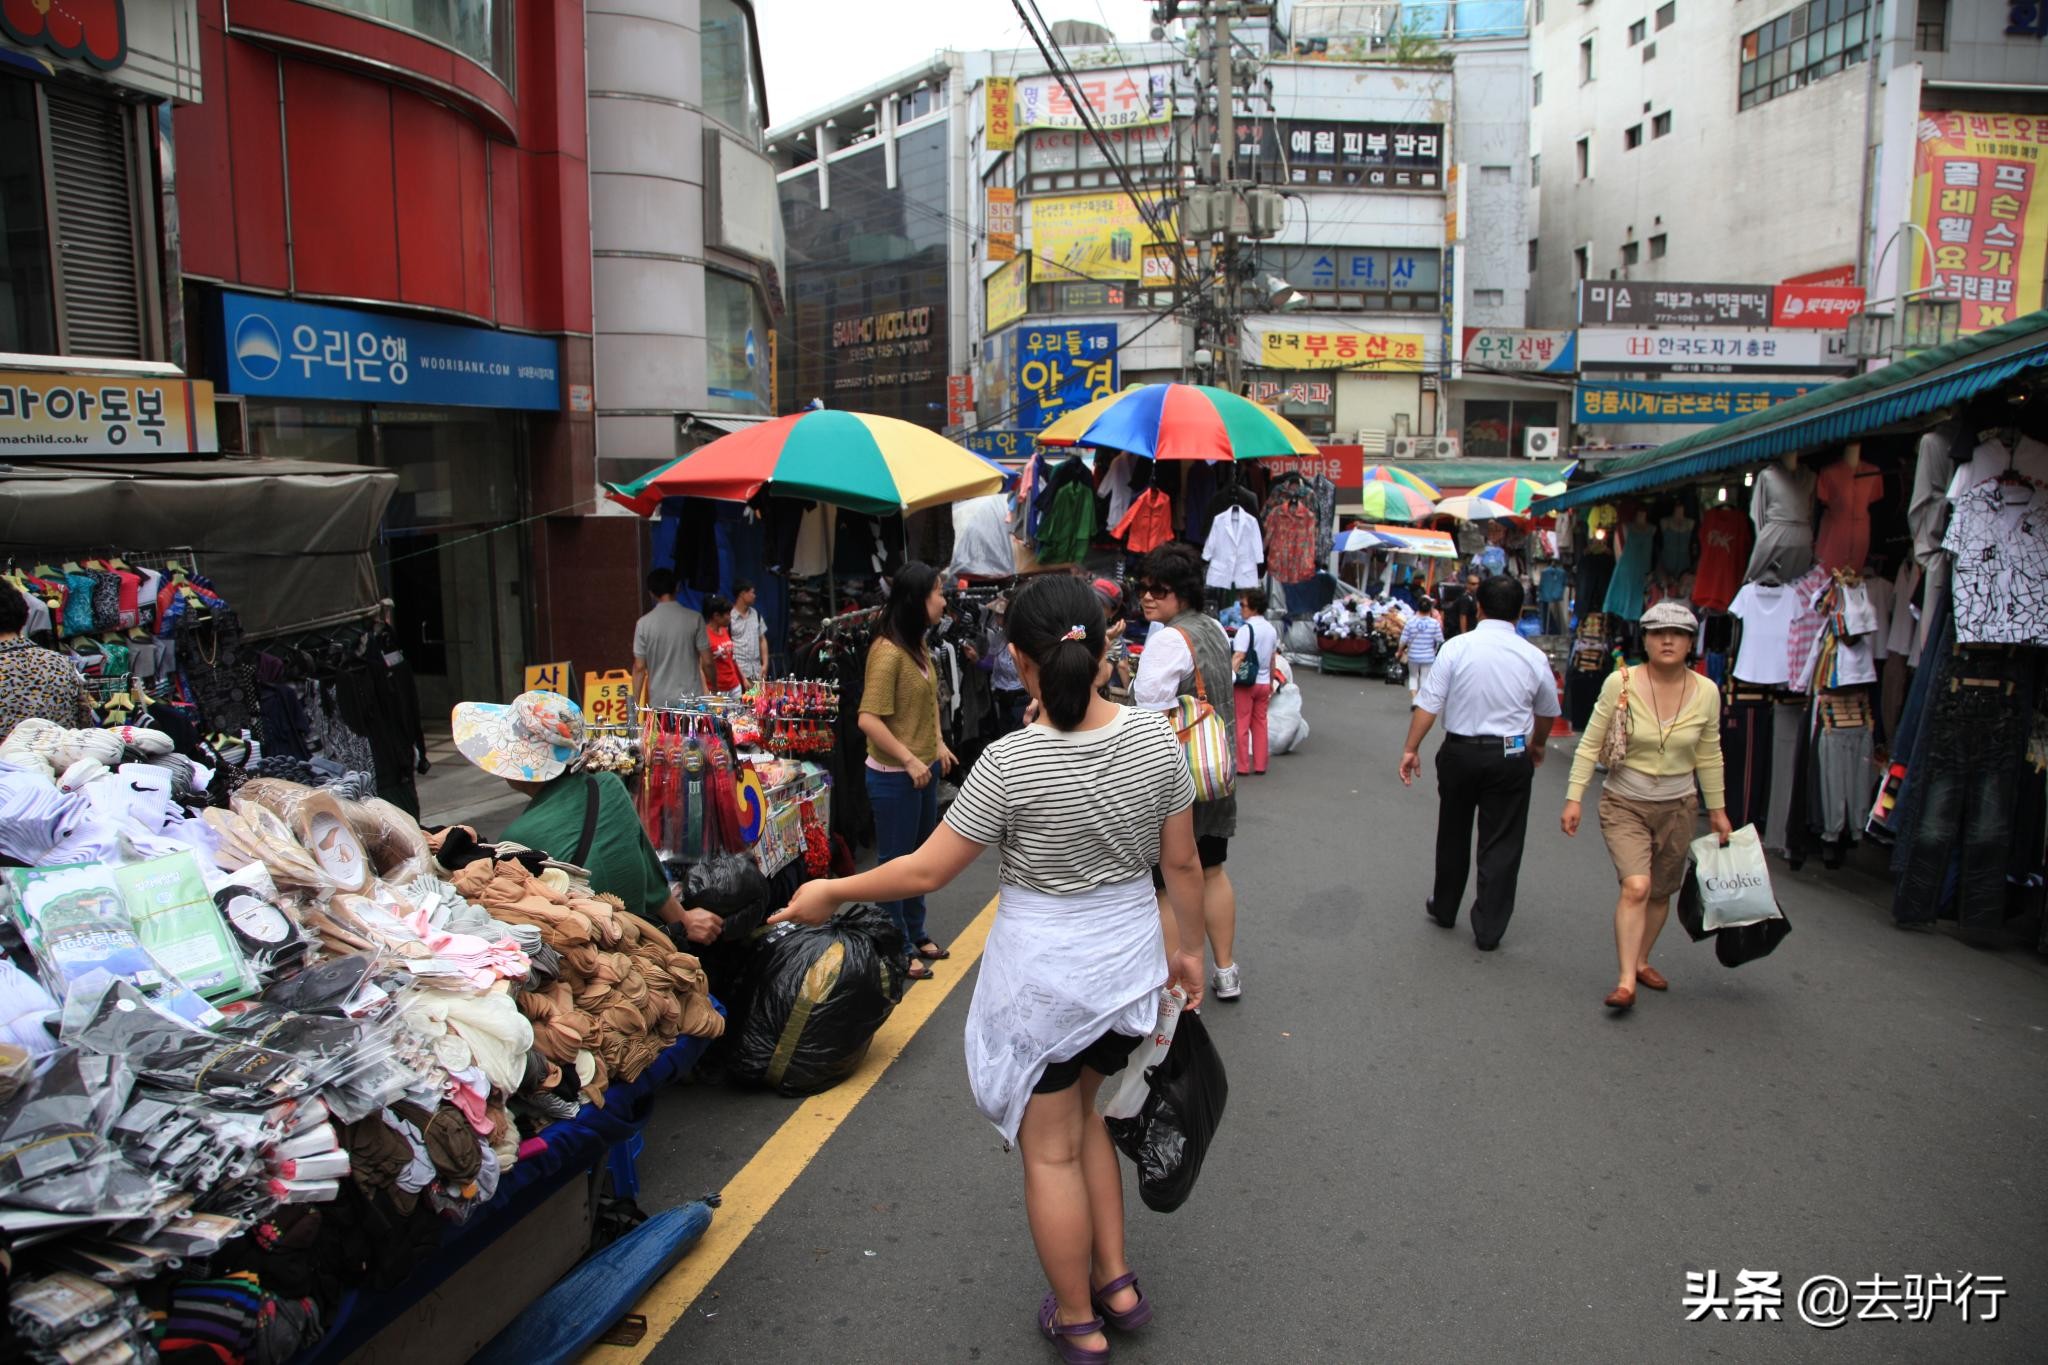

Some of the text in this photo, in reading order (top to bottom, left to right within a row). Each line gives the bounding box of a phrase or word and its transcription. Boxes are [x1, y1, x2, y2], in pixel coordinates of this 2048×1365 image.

[1048, 78, 1140, 114] 칼국수
[1943, 161, 2027, 191] 골프
[1939, 189, 2022, 220] 레슨
[1936, 217, 2016, 247] 헬스
[1934, 245, 2013, 276] 요가
[1591, 287, 1632, 321] 미소
[1805, 297, 1861, 314] 롯데리아
[290, 325, 408, 385] 우리은행
[1027, 331, 1083, 356] 우리들
[1268, 334, 1417, 359] 한국 부동산 2층
[1475, 336, 1554, 361] 우진신발
[1658, 338, 1742, 356] 한국도자기
[1746, 339, 1777, 357] 총판
[420, 356, 510, 376] WOORIBANK.COM
[1022, 359, 1115, 409] 안경
[1291, 381, 1332, 404] 치과
[0, 385, 166, 447] 마아동복
[592, 699, 629, 722] 안경
[1706, 873, 1762, 891] Cookie
